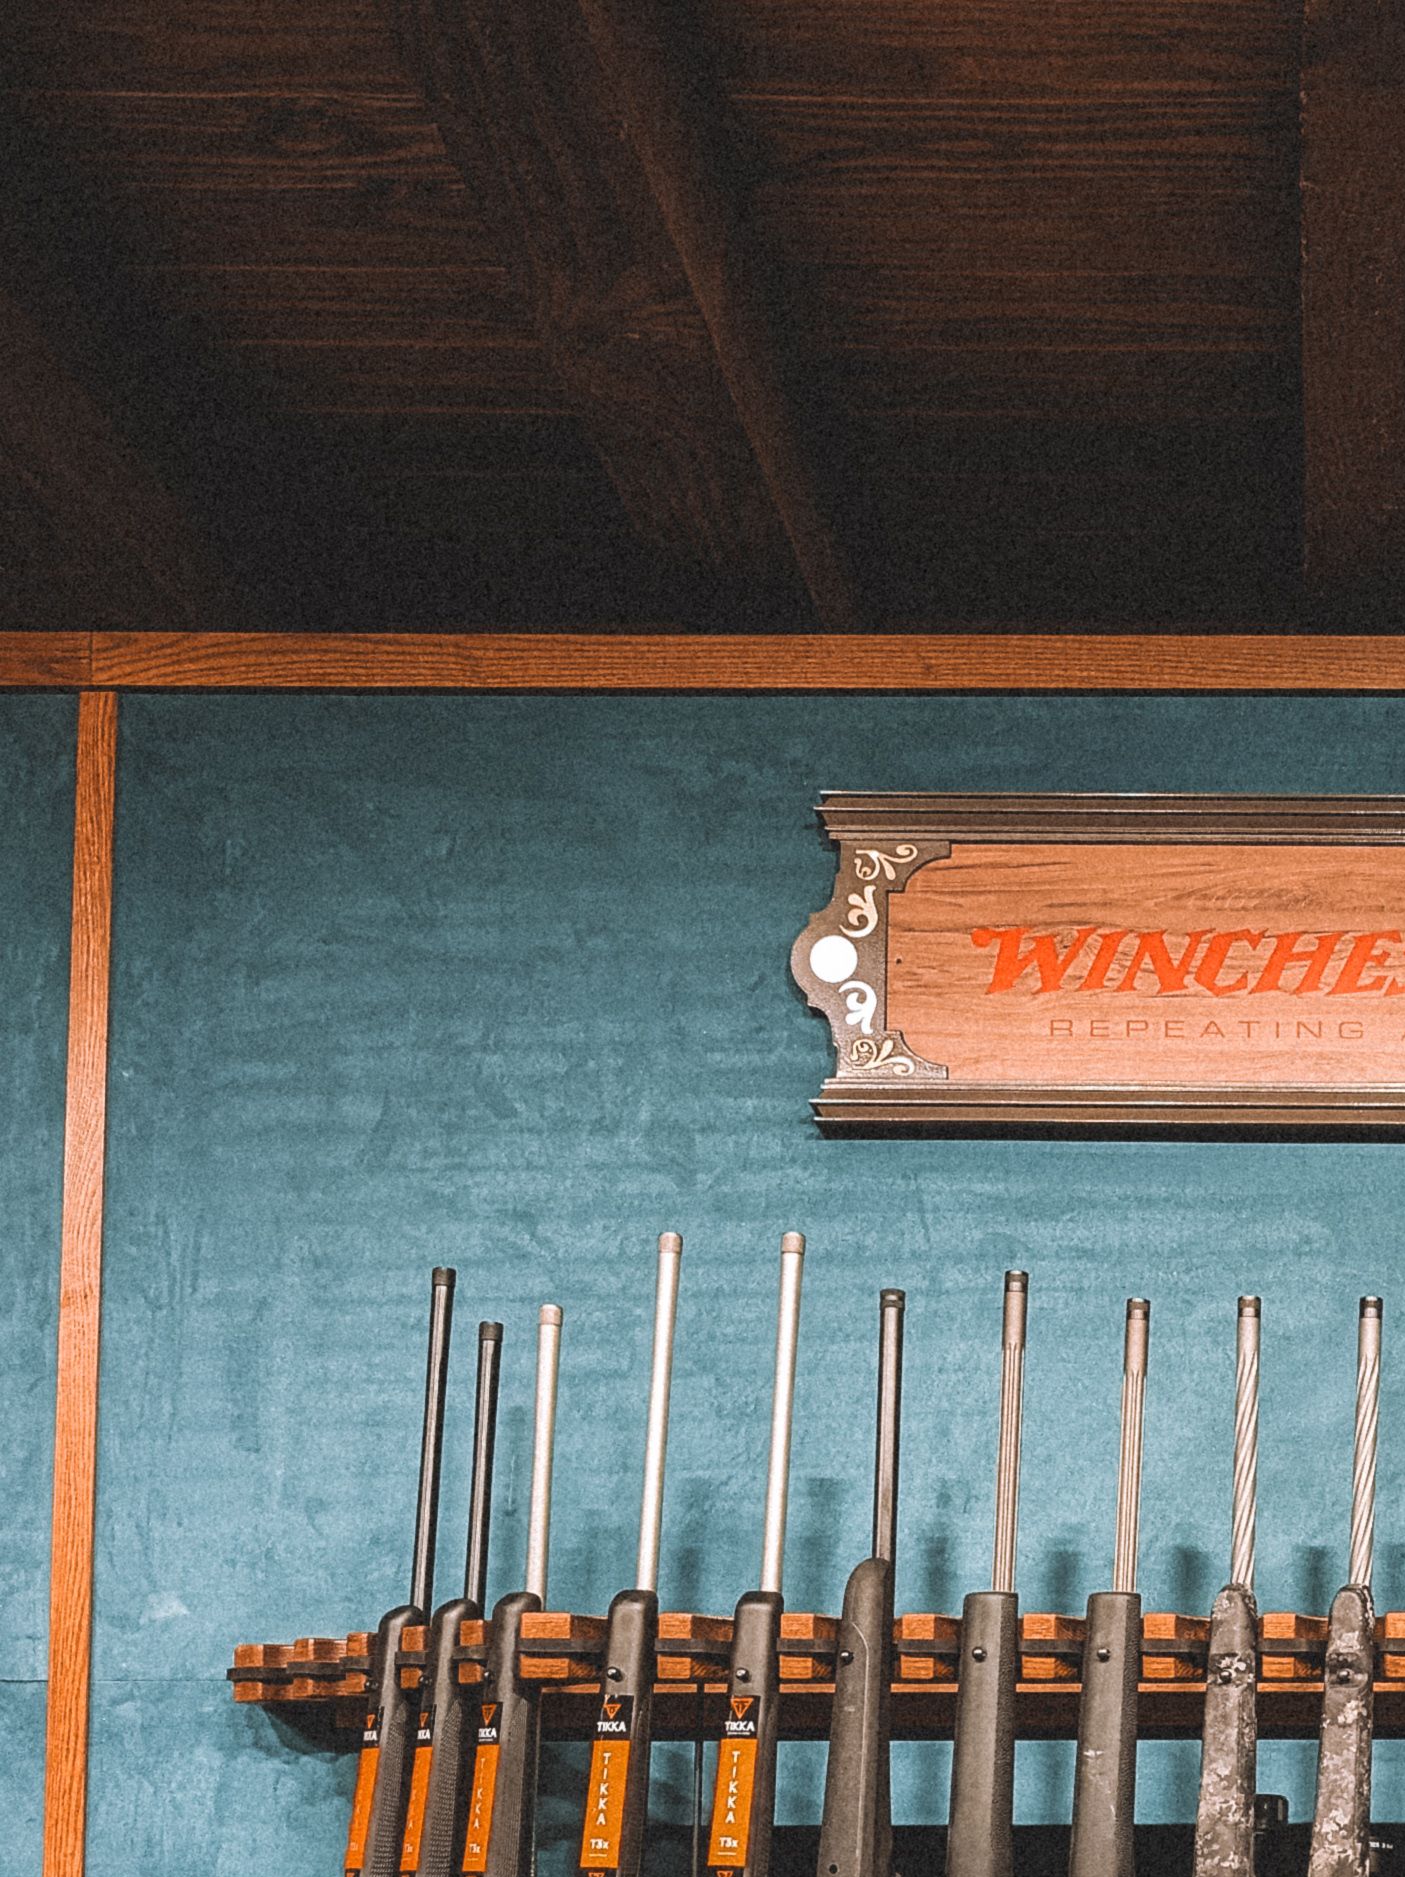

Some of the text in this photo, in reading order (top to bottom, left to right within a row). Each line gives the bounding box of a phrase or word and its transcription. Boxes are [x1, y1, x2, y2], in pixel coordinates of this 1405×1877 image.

[1049, 1019, 1364, 1039] REPEATING
[597, 1721, 627, 1732] TIKKA
[725, 1720, 755, 1732] TIKKA
[596, 1752, 612, 1826] TIKKA
[725, 1750, 741, 1824] TIKKA
